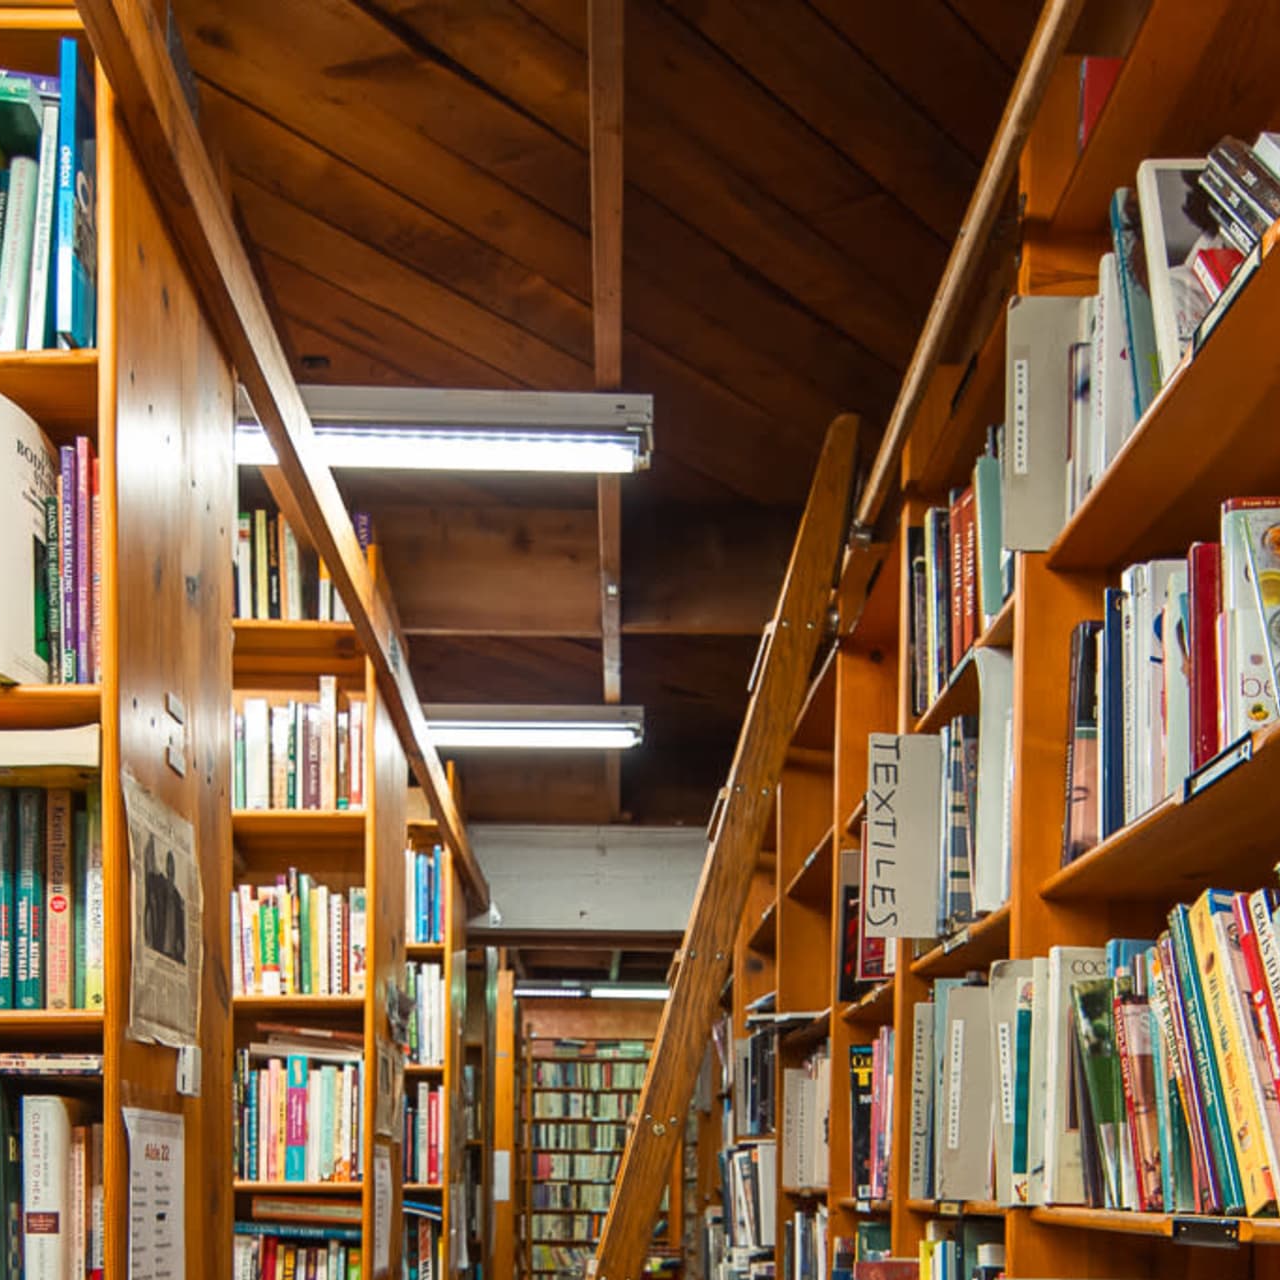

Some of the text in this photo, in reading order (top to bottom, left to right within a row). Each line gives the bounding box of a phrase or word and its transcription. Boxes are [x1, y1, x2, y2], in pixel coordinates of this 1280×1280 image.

[60, 146, 73, 189] detox
[63, 503, 74, 593] CHAKRA HEALING
[52, 807, 66, 894] Kevin Trudeau
[867, 737, 900, 928] TEXTILES
[1253, 902, 1274, 953] CRAFTS
[1266, 955, 1279, 974] TO
[1114, 1006, 1134, 1098] SIMPLE GIFTS
[32, 1113, 41, 1207] CLEANSE TO HEAL
[161, 1144, 170, 1161] 22
